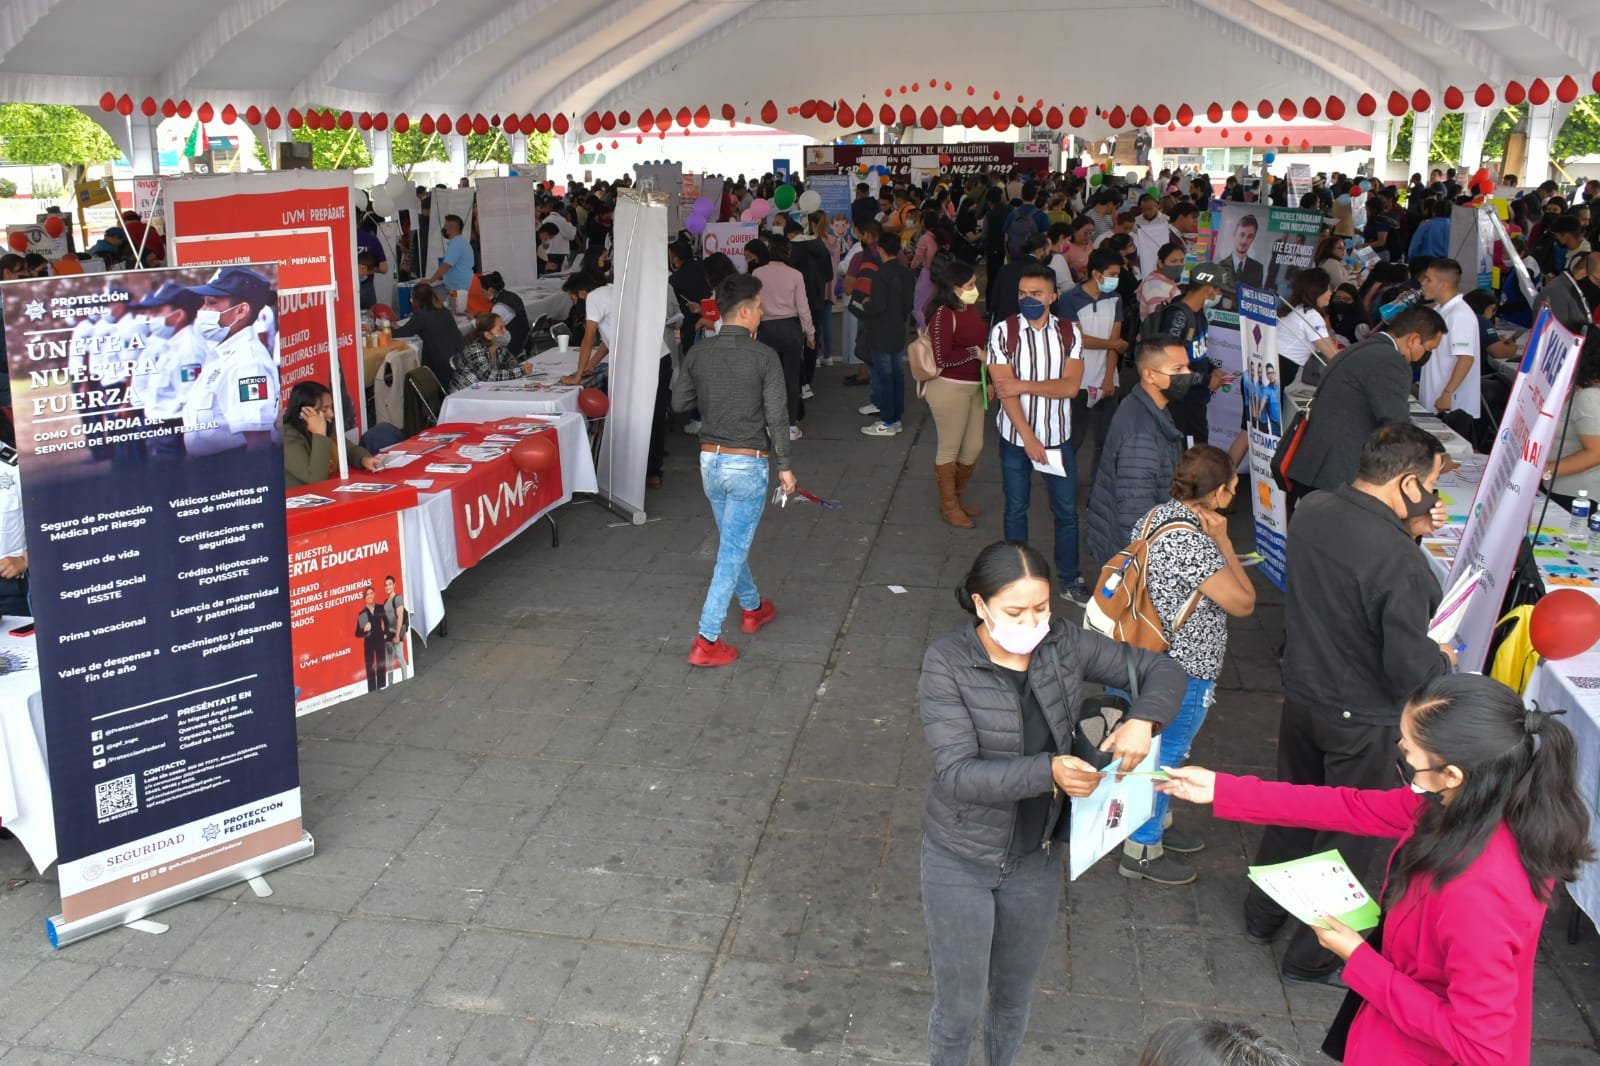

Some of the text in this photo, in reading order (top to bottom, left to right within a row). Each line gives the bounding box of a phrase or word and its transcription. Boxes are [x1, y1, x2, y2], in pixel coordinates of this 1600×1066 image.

[282, 205, 345, 225] UVM PREPÁRATE
[291, 255, 327, 265] PREPÁRATE
[1283, 243, 1314, 256] ESTAMOS
[50, 291, 129, 307] PROTECCIÓN
[52, 305, 109, 319] FEDERAL
[25, 332, 147, 361] ÚNETE A
[28, 357, 160, 389] NUESTRA
[238, 376, 267, 386] MÉXICO
[31, 387, 143, 417] FUERZA
[33, 416, 166, 443] COMO GUARDIA DEL
[34, 419, 220, 455] SERVICIO DE PROTECCIÓN FEDERAL
[169, 484, 269, 509] Viáticos cubiertos en
[176, 495, 263, 518] caso de movilidad
[464, 470, 525, 540] UVM
[40, 504, 153, 533] Seguro de Protección
[50, 516, 147, 542] Médica por Riesgo
[178, 521, 265, 544] Certificaciones en
[198, 533, 246, 551] seguridad
[61, 548, 140, 572] Seguro de vida
[294, 544, 333, 561] NUESTRA
[320, 540, 389, 570] EDUCATIVA
[177, 564, 214, 580] Crédito
[214, 554, 269, 573] Hipotecario
[199, 567, 250, 587] FOVISSSTE
[60, 574, 147, 600] Seguridad Social
[86, 590, 123, 606] ISSSTE
[329, 578, 372, 599] INGENIERÍAS
[170, 586, 280, 618] Licencia de maternidad
[325, 591, 364, 609] EJECUTIVAS
[195, 601, 256, 624] y paternidad
[58, 616, 147, 644] Prima vacacional
[170, 620, 283, 654] Crecimiento y desarrollo
[202, 636, 254, 657] profesional
[58, 664, 87, 680] Vales
[88, 661, 102, 672] de
[103, 652, 152, 670] despensa
[299, 647, 352, 670] UVM PREPÁRATE
[84, 663, 137, 684] fin de año
[177, 690, 252, 717] PRESÉNTATE EN
[177, 719, 187, 727] Av
[187, 713, 209, 724] Miguel
[210, 707, 229, 718] Ángel
[178, 722, 207, 735] Quevedo
[179, 730, 235, 750] Ciudad de México
[143, 758, 186, 777] CONTACTO
[223, 800, 284, 826] PROTECCIÓN
[224, 815, 266, 836] FEDERAL
[107, 833, 186, 868] SEGURIDAD
